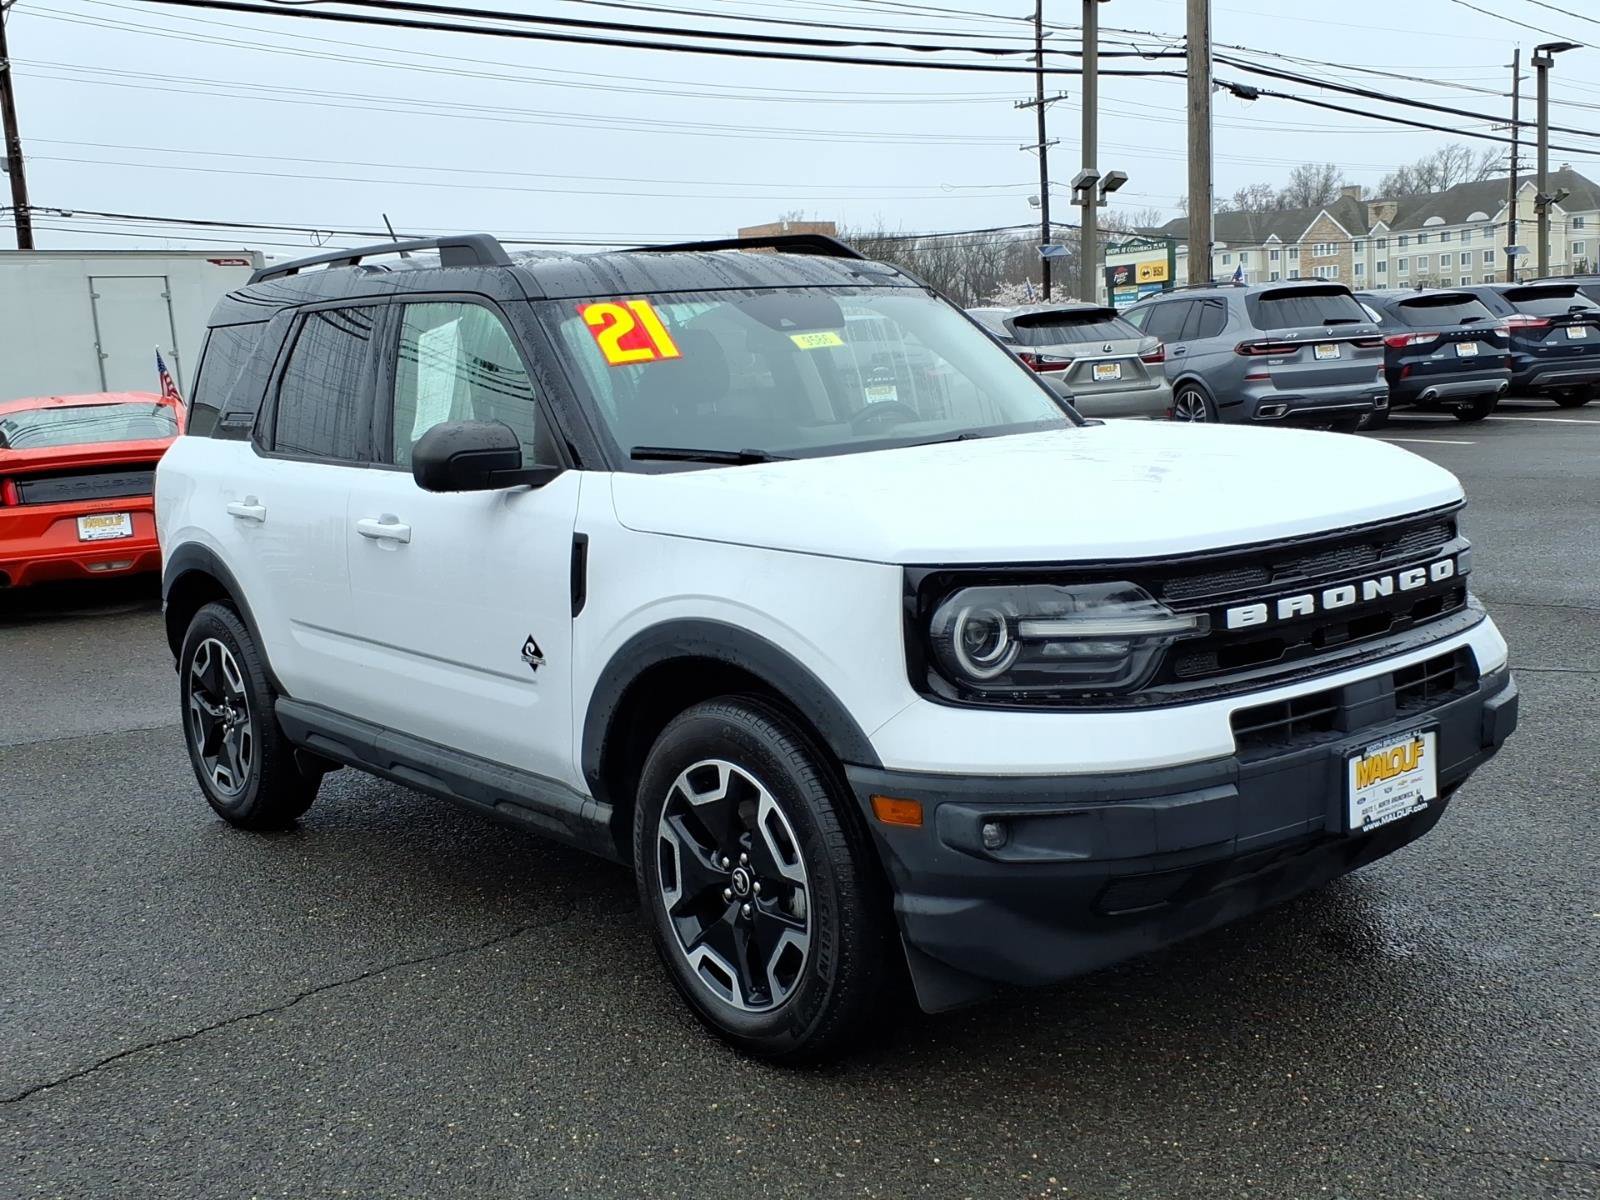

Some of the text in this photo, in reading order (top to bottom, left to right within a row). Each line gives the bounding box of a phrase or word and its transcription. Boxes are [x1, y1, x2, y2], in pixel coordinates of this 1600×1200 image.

[583, 300, 680, 363] 21
[1226, 559, 1454, 630] BRONCO
[1356, 740, 1424, 790] MALOUF
[1362, 802, 1428, 833] www.MALOUF.com
